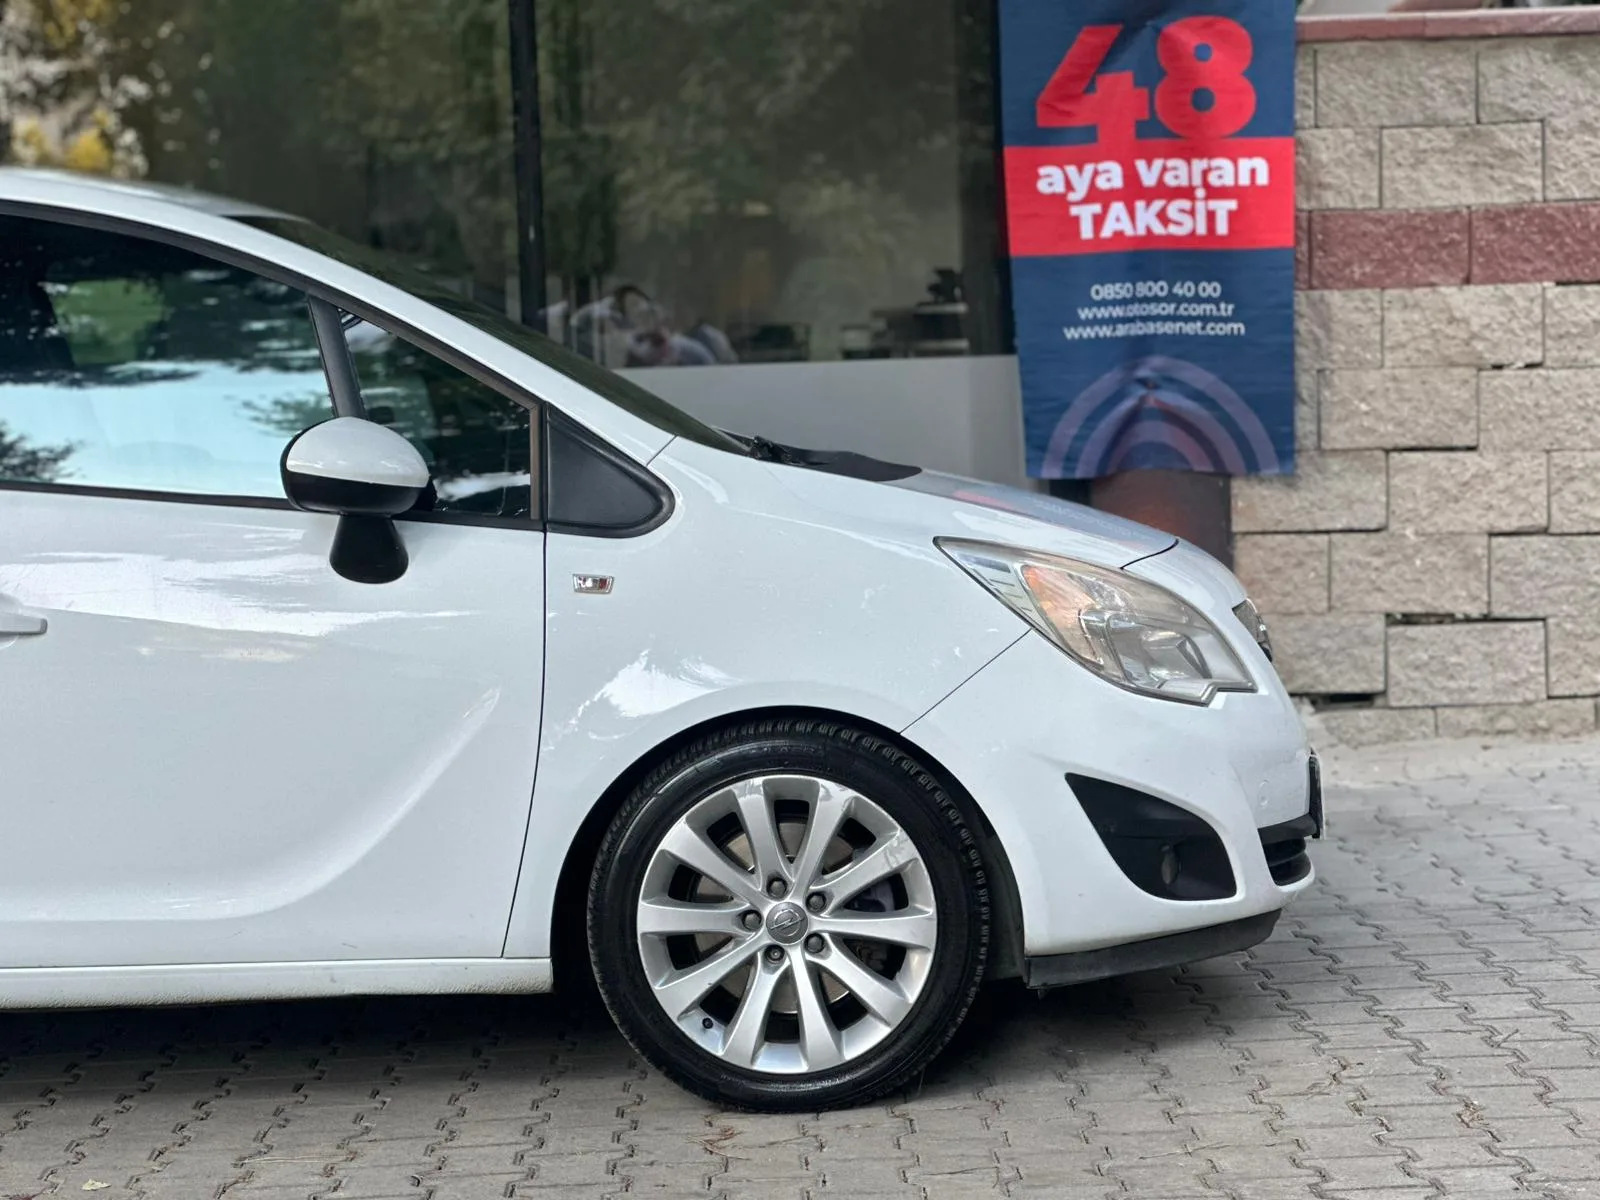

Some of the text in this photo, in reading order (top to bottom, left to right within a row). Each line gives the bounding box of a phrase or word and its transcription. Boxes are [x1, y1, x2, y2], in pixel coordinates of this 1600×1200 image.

[1036, 15, 1256, 143] 48
[1036, 156, 1269, 202] aya varan
[1069, 188, 1238, 240] TAKSİT
[1090, 283, 1133, 300] 0850
[1172, 281, 1196, 298] 40
[1197, 282, 1222, 298] 00
[1063, 319, 1246, 340] www.arabasenet.com
